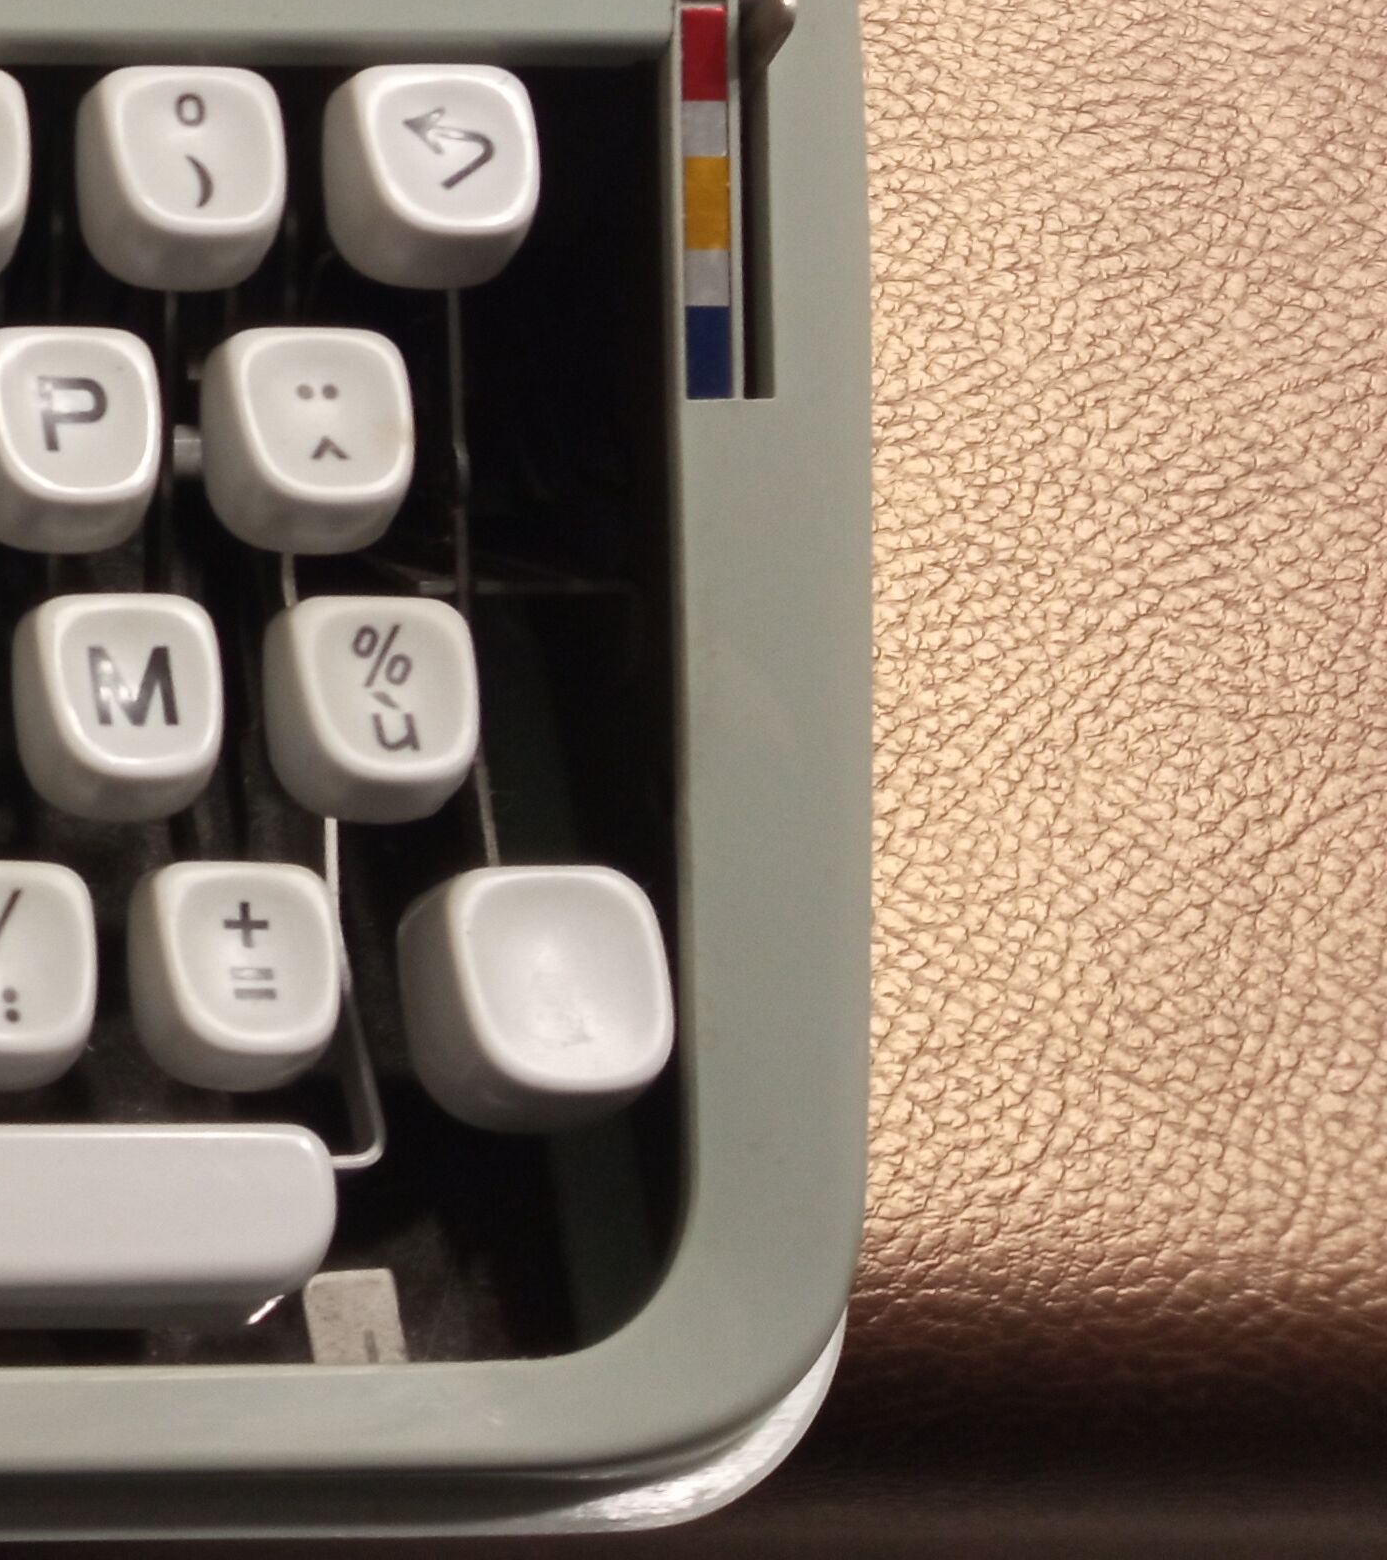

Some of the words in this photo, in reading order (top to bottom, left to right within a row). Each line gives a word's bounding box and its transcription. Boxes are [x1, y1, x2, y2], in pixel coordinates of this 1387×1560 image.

[185, 154, 213, 208] )
[36, 375, 107, 452] P
[88, 645, 179, 726] M
[351, 622, 413, 689] %
[370, 691, 421, 753] ù
[223, 901, 270, 949] +
